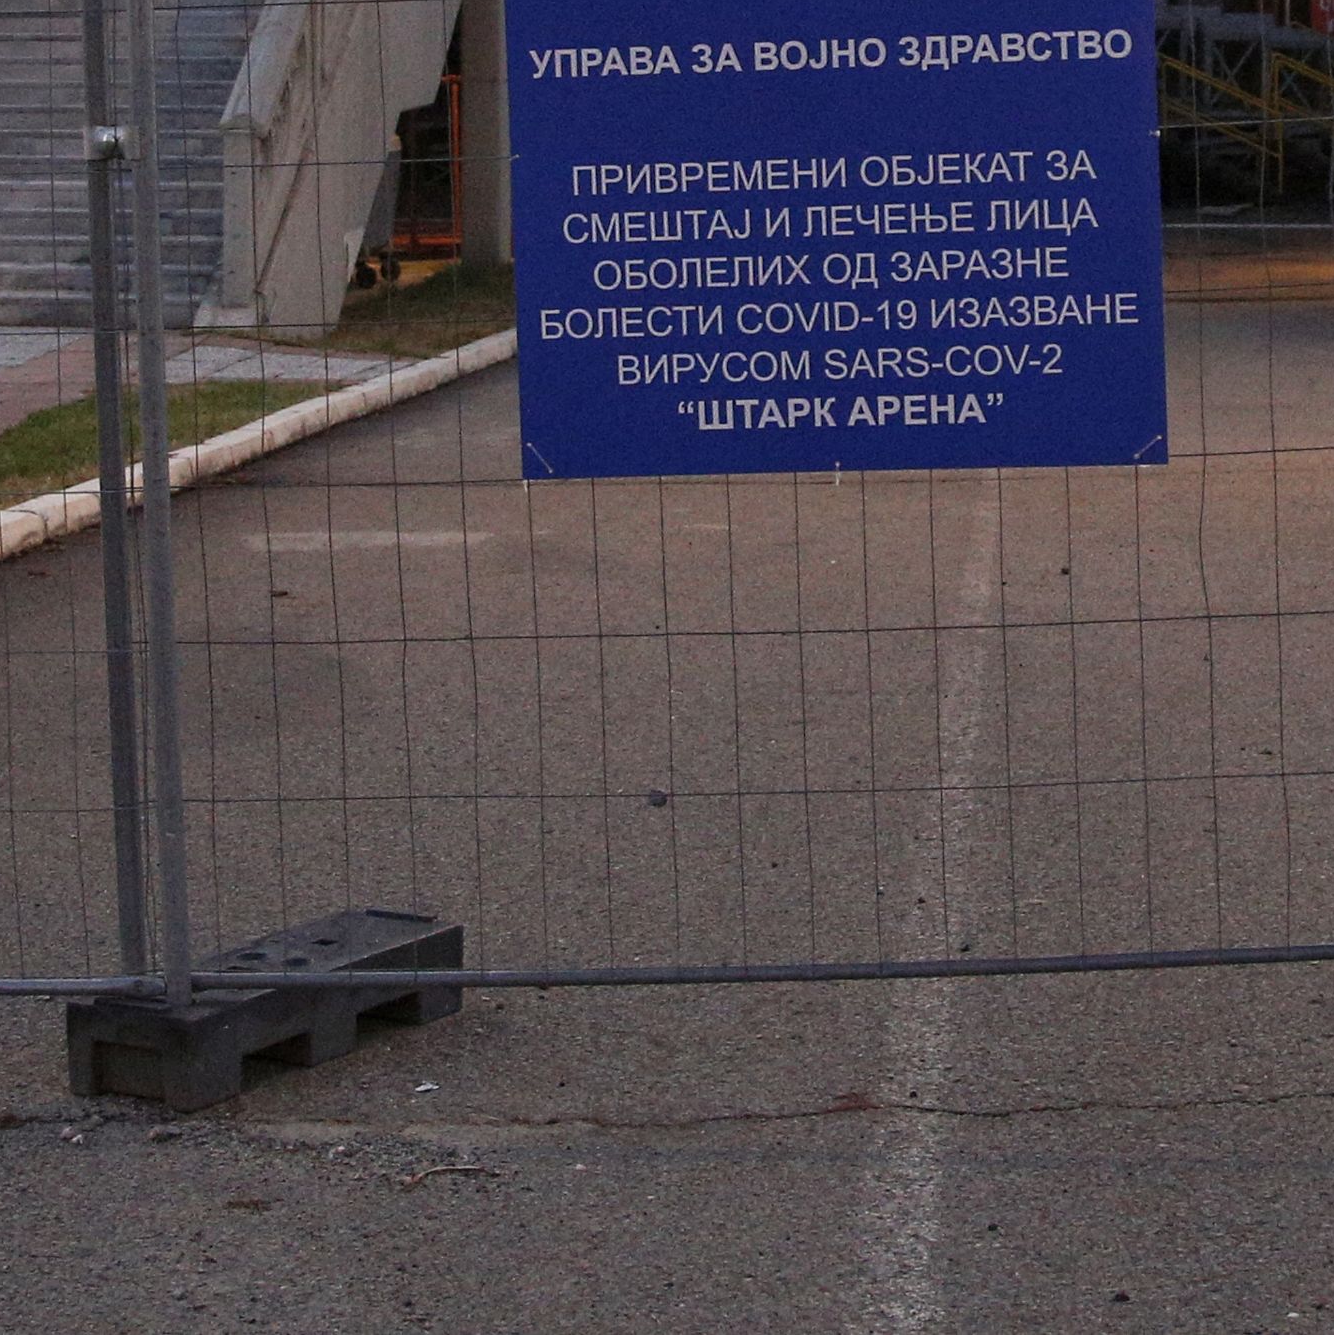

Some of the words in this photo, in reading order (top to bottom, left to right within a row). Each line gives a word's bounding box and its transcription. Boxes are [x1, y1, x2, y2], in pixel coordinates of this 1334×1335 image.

[530, 46, 680, 78] УПРАВА
[692, 44, 741, 73] ЗА
[755, 38, 886, 70] ВОЈНО
[899, 29, 1131, 70] ЗДРАВСТВО
[573, 158, 845, 195] ПРИВРЕМЕНИ
[861, 152, 1033, 186] ОБЈЕКАТ
[1047, 150, 1096, 180] ЗА
[564, 209, 750, 243] СМЕШТАЈ
[766, 208, 789, 237] И
[804, 202, 974, 236] ЛЕЧЕЊЕ
[987, 198, 1098, 235] ЛИЦА
[594, 255, 810, 290] ОБОЛЕЛИХ
[824, 253, 878, 289] ОД
[891, 247, 1068, 281] ЗАРАЗНЕ
[541, 306, 722, 339] БОЛЕСТИ
[737, 300, 916, 333] COVID-19
[931, 294, 1138, 328] ИЗАЗВАНЕ
[619, 351, 809, 384] ВИРУСОМ
[825, 344, 1062, 379] SARS-COV-2
